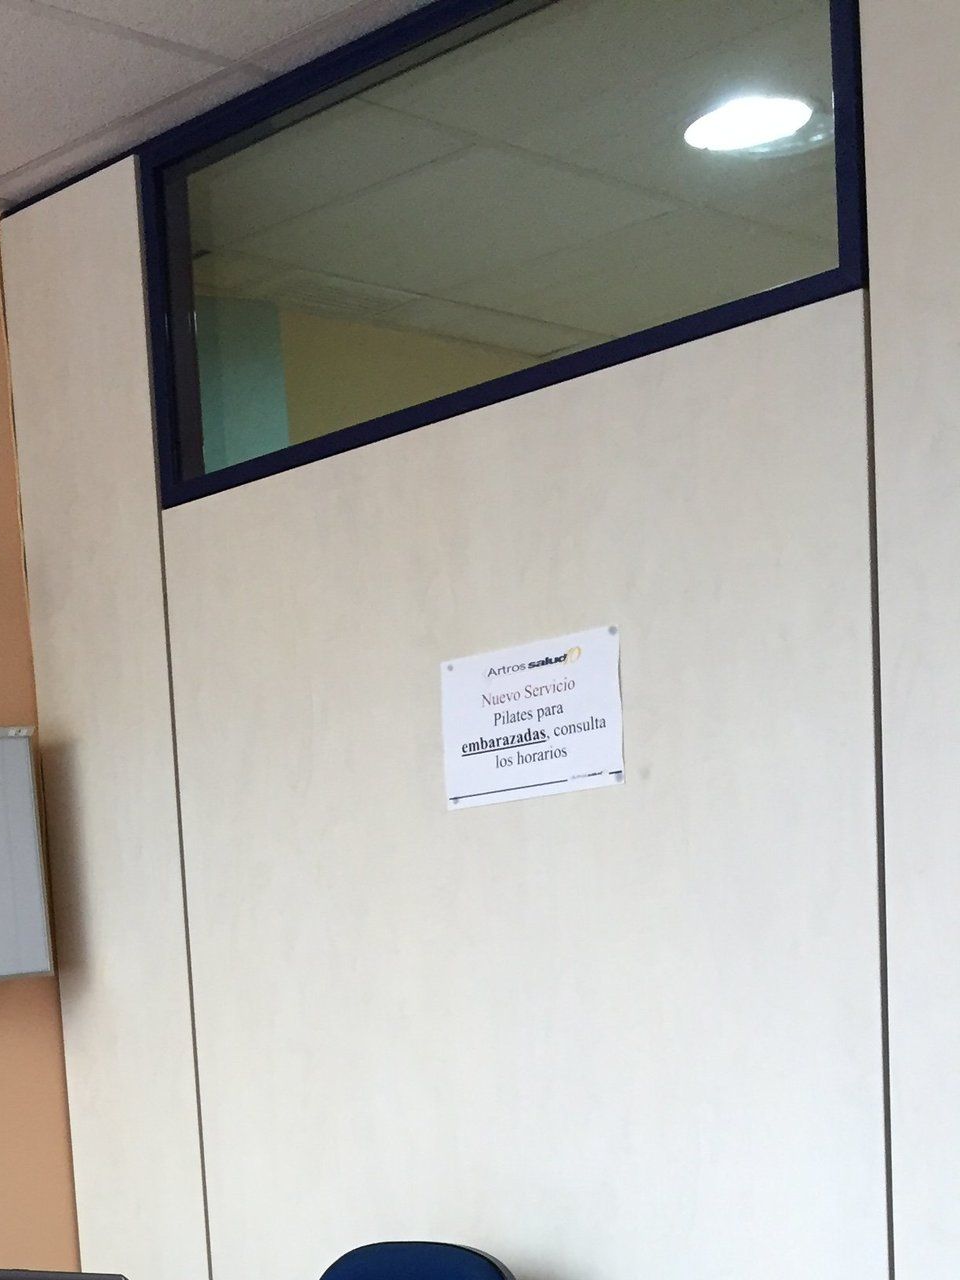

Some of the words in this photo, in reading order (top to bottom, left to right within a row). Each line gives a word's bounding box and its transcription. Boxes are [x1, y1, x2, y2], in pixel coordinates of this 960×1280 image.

[481, 690, 521, 708] Nuevo
[524, 676, 576, 699] Servicio
[493, 709, 534, 727] Pilates
[536, 703, 564, 723] para
[461, 728, 551, 757] embarazadas,
[553, 715, 607, 738] consulta
[495, 753, 514, 769] los
[517, 746, 569, 766] horarios
